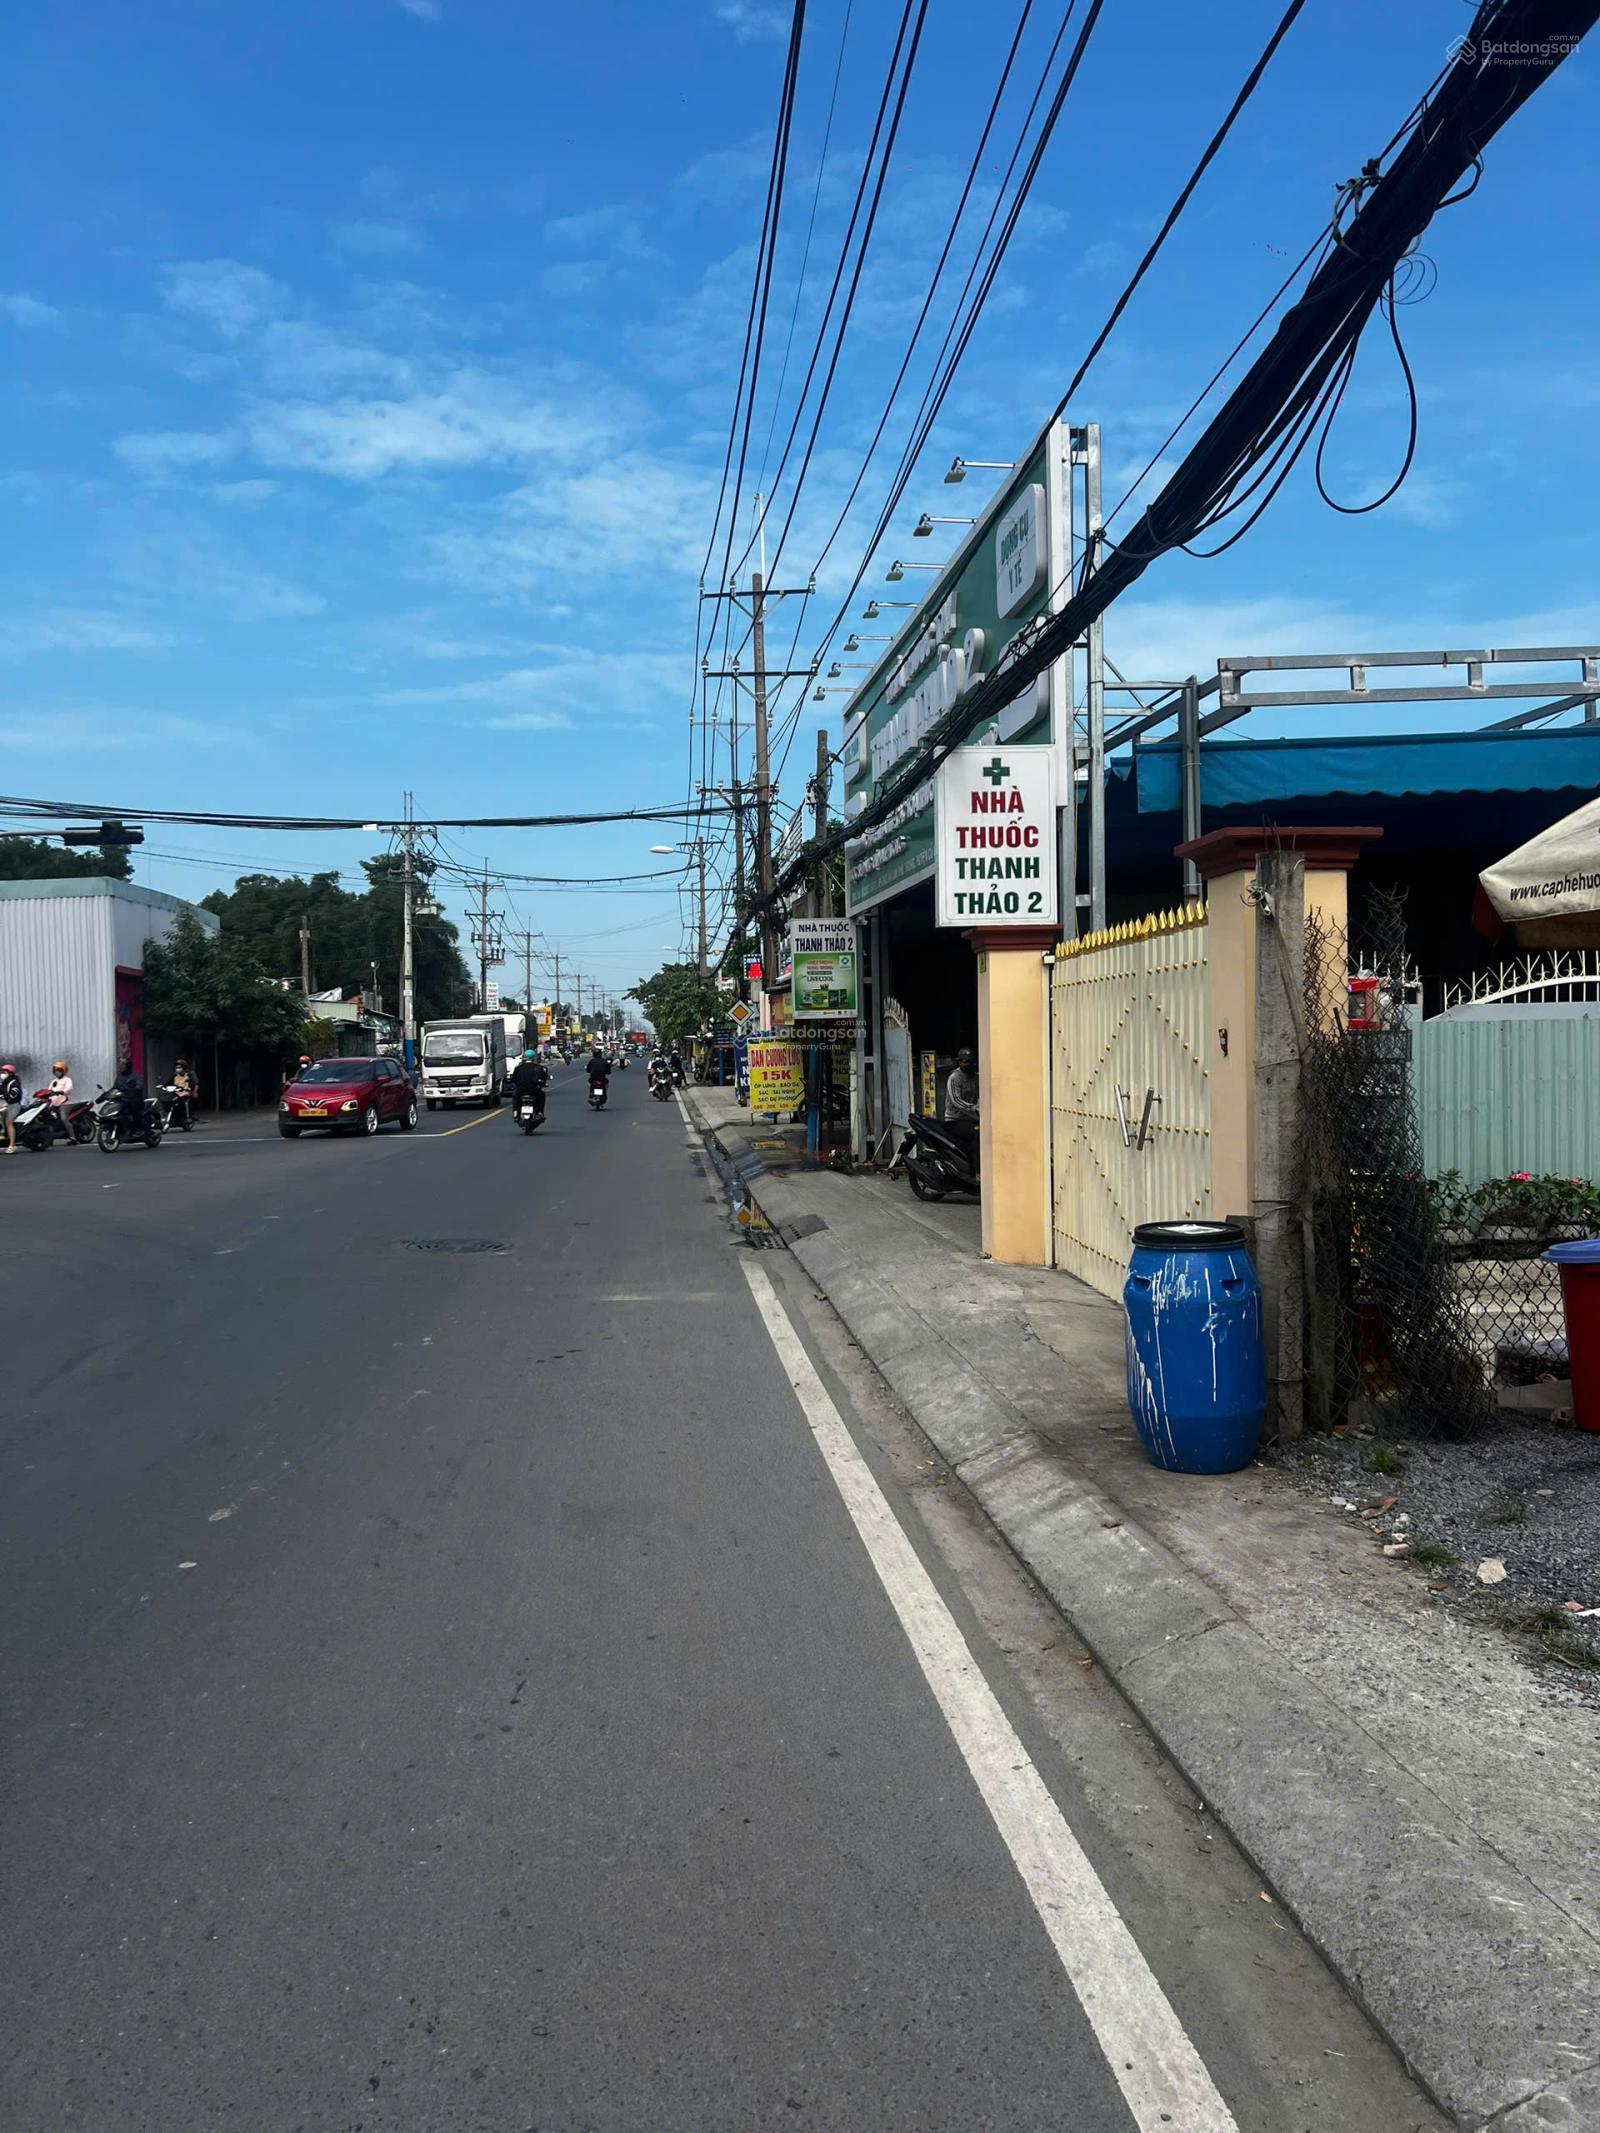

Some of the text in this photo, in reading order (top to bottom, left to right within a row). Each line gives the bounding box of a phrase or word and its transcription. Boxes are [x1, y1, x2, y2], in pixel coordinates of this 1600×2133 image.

[971, 785, 1025, 813] NHÀ
[956, 817, 1039, 848] THUỐC
[955, 857, 1040, 879] THANH
[954, 883, 1042, 914] THẢO 2
[798, 920, 849, 932] NHÀ THUỐC
[795, 932, 853, 952] THANH THẢO 2
[761, 1070, 792, 1081] 15K
